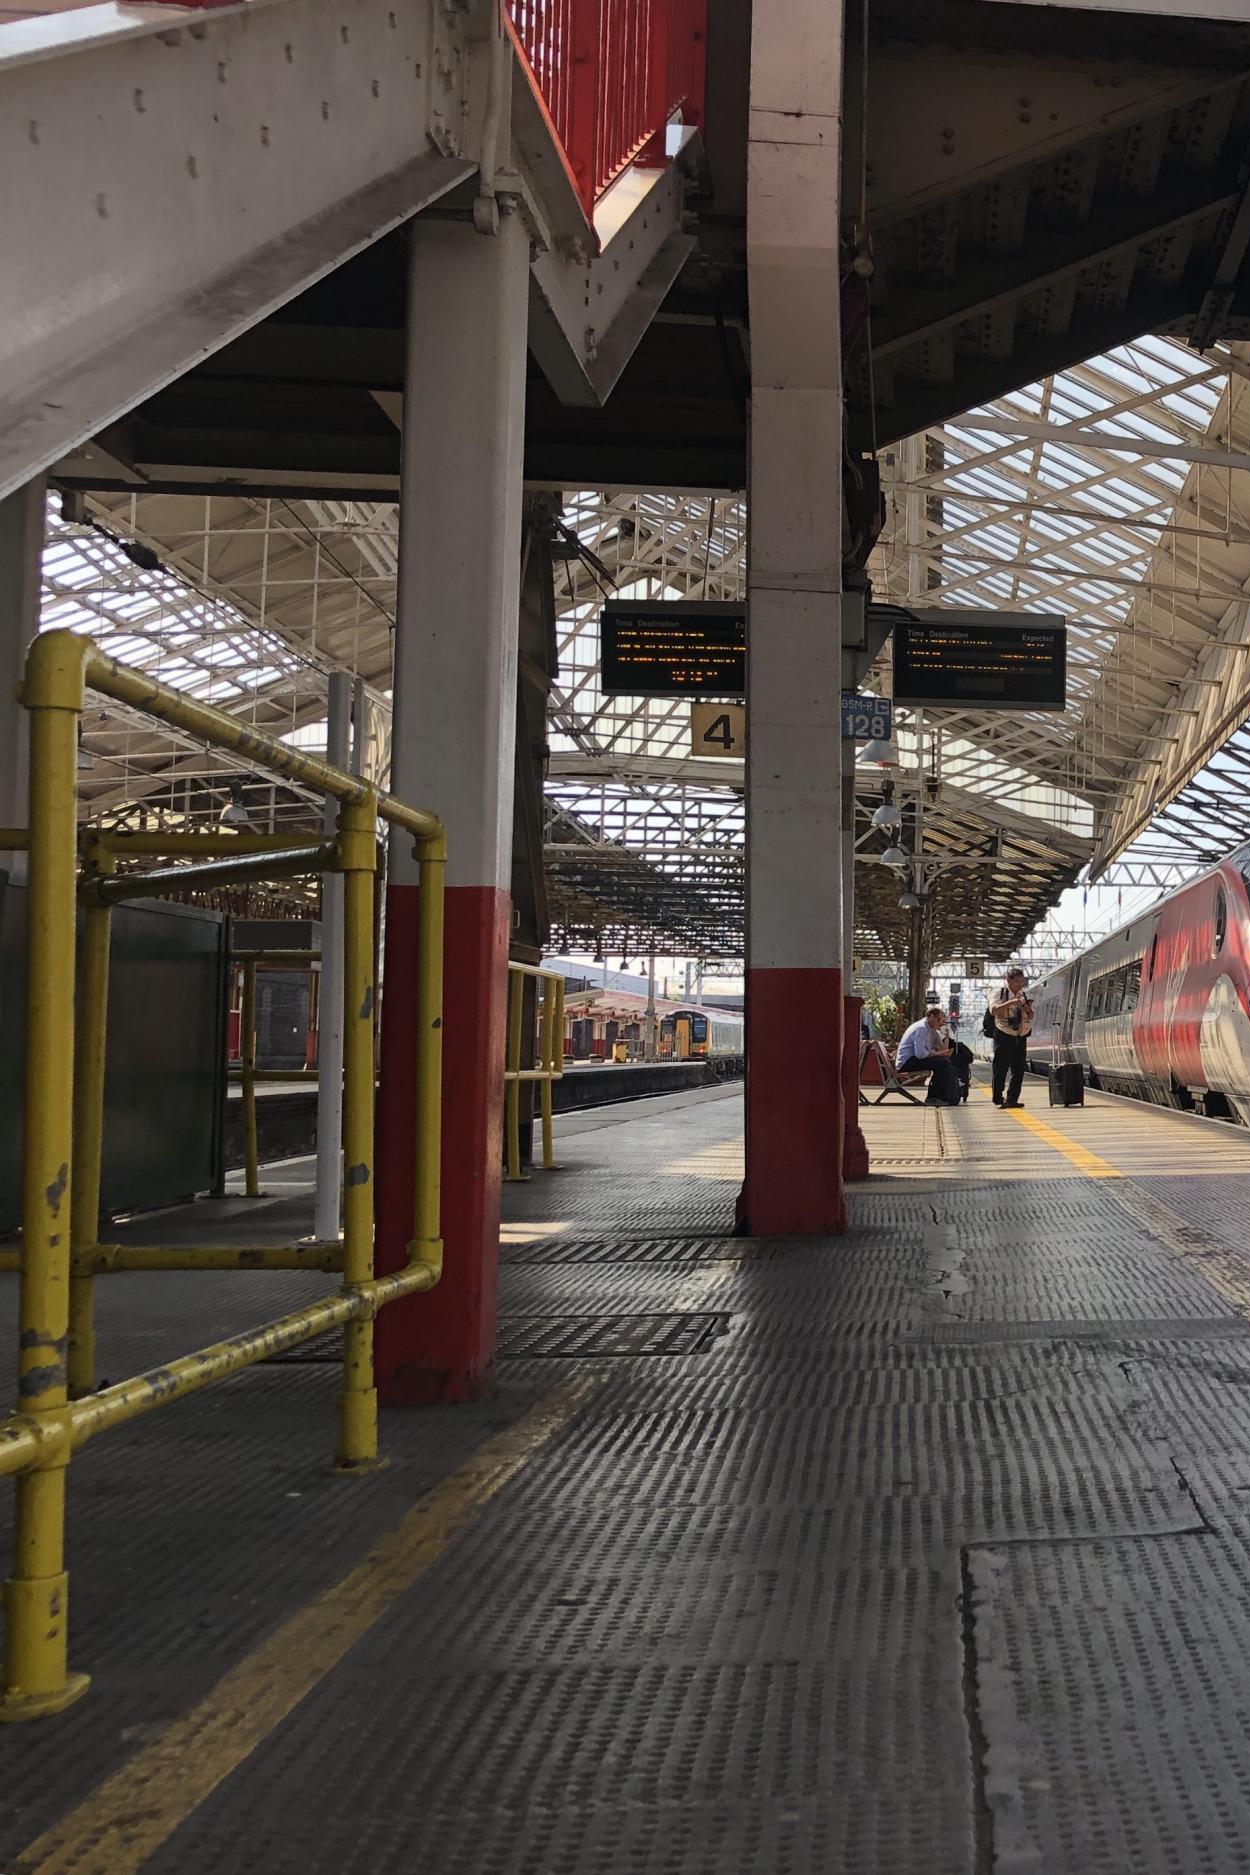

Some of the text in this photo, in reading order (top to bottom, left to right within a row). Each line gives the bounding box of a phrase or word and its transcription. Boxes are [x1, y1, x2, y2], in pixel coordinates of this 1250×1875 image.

[908, 630, 1055, 643] Time Destination Expected
[703, 714, 736, 750] 4
[846, 714, 885, 738] 128
[970, 962, 980, 975] 5
[587, 999, 594, 1008] 2
